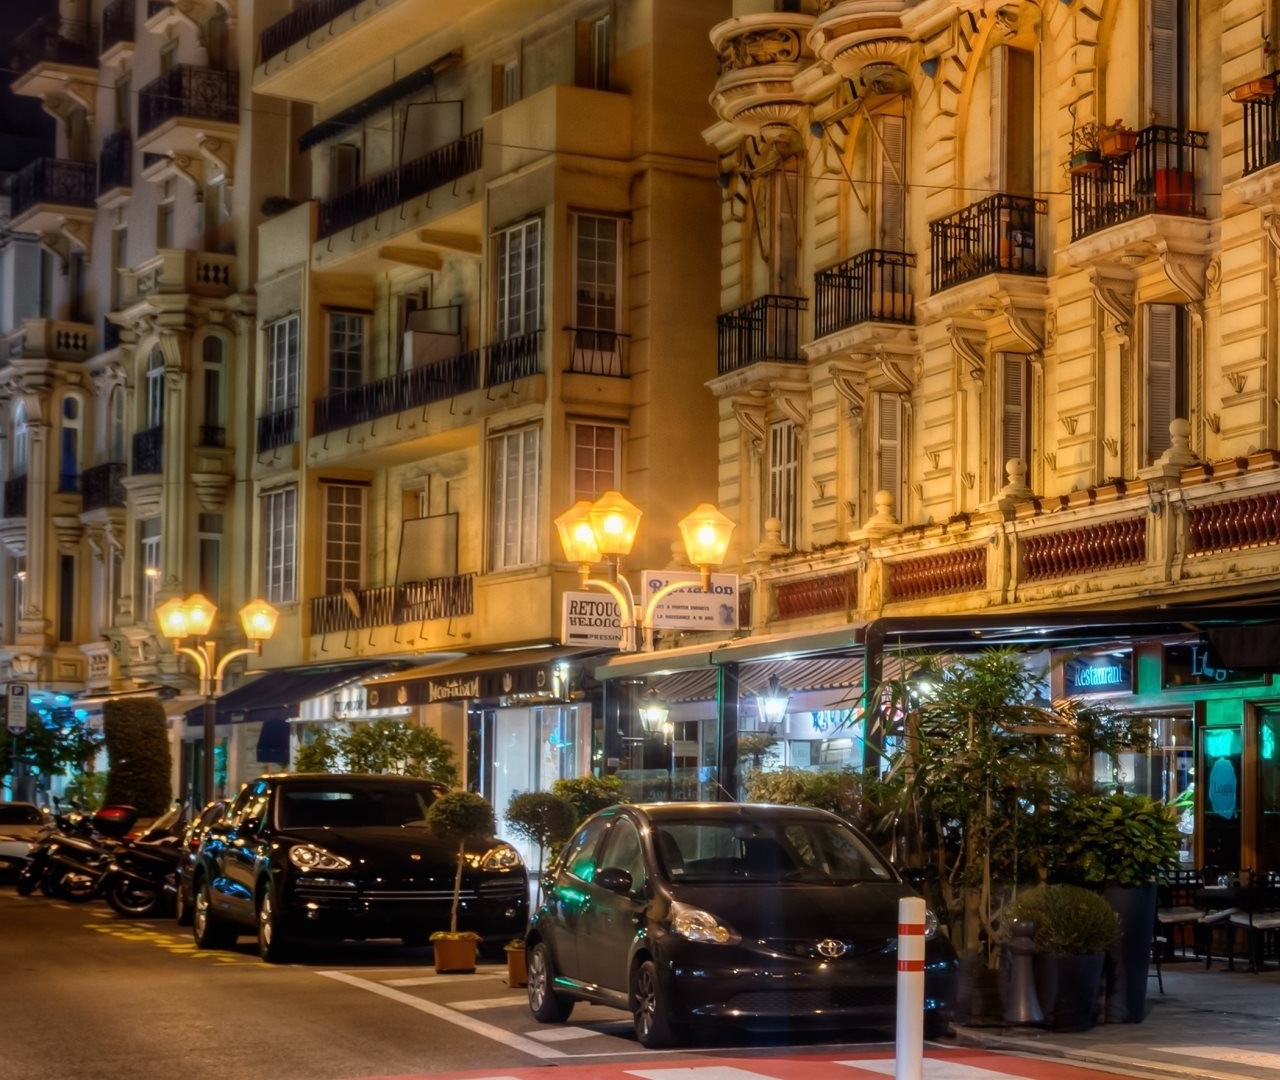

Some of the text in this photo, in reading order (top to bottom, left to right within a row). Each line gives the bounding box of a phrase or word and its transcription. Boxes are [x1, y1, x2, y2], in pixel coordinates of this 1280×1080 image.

[569, 600, 621, 617] RETOUC
[588, 633, 622, 641] PRESSIN
[1074, 663, 1123, 687] Restaurant
[1213, 782, 1233, 796] Loga
